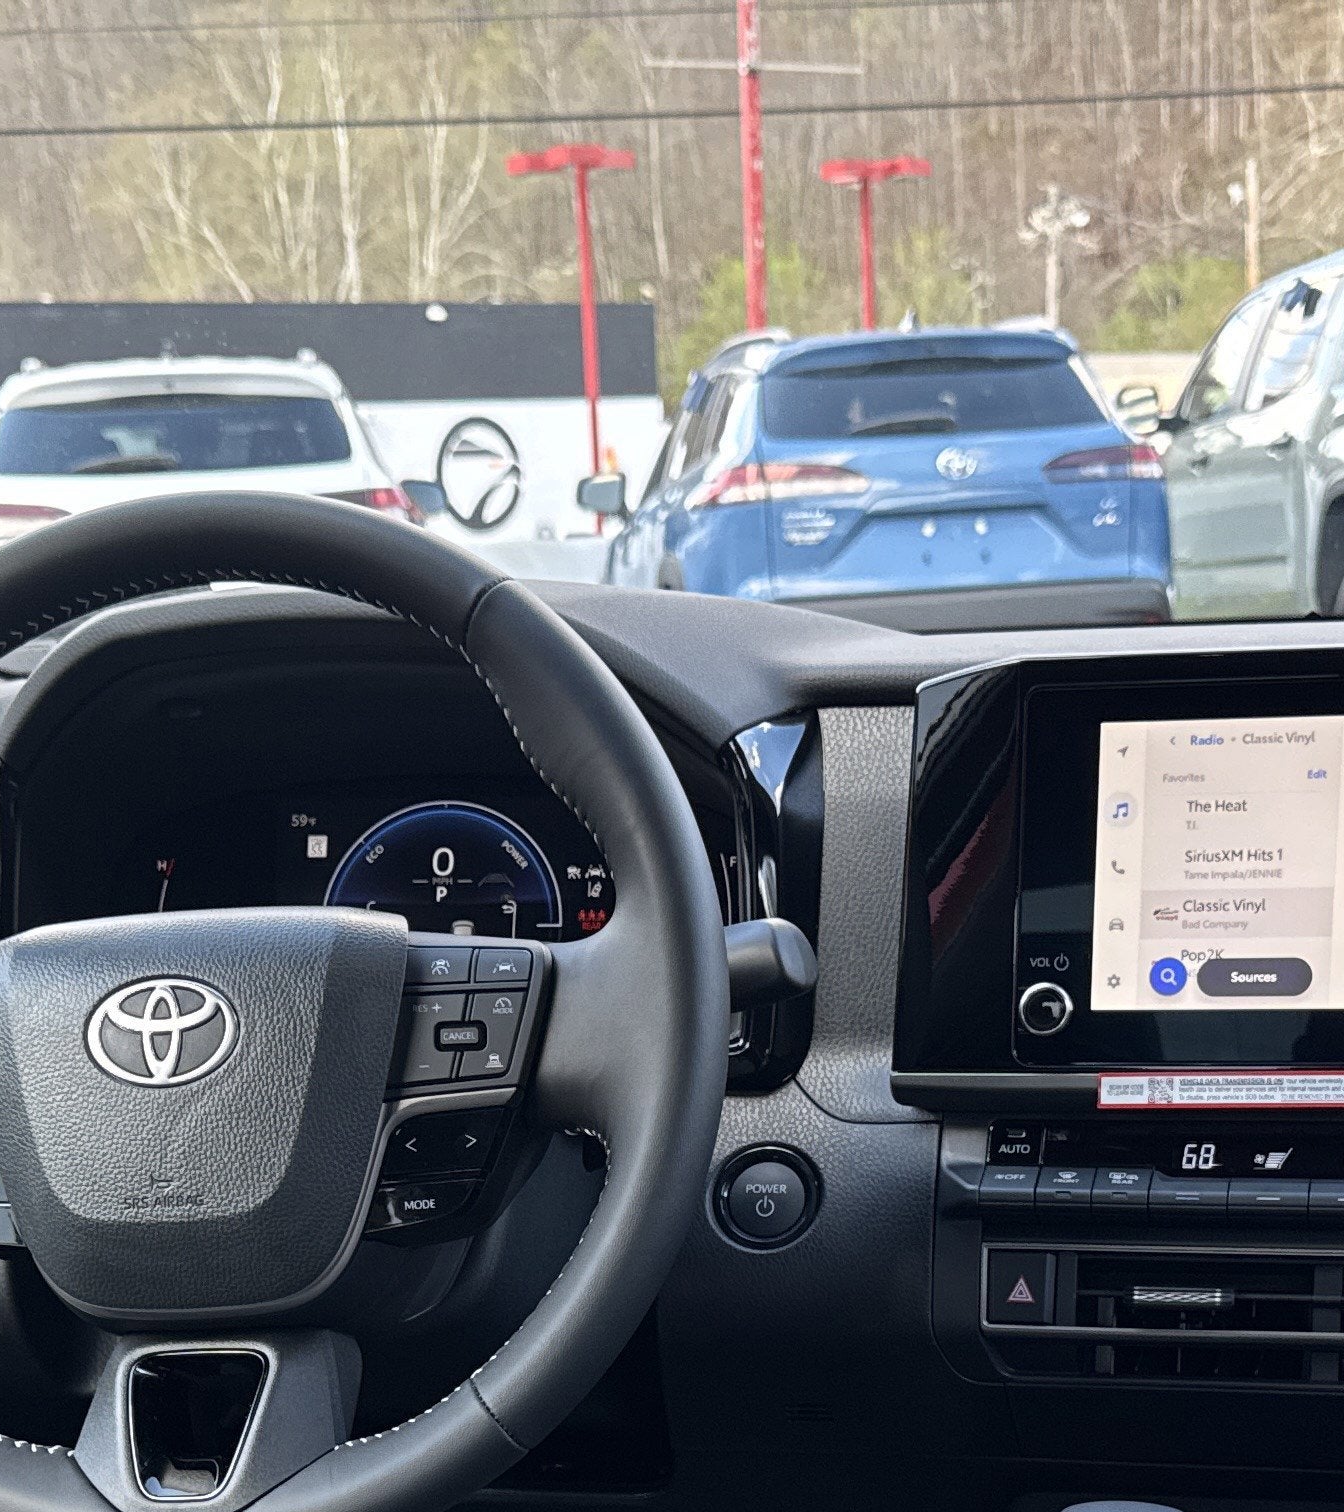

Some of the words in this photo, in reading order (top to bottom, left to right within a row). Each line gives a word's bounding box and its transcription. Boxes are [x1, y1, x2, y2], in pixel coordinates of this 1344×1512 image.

[1190, 734, 1224, 746] Radio
[1242, 732, 1284, 745] Classic
[1285, 730, 1316, 744] Vinyl
[1162, 772, 1205, 783] Favorites
[1306, 768, 1328, 780] Edit
[1186, 800, 1212, 813] The
[1214, 799, 1248, 813] Heat
[365, 843, 385, 865] ECO
[500, 839, 530, 870] POWER
[1184, 849, 1244, 864] SiriusXM
[1247, 849, 1274, 863] Hits
[1276, 848, 1284, 862] 1
[156, 859, 168, 872] H
[431, 846, 455, 877] 0
[729, 855, 737, 868] F
[431, 876, 454, 886] MPH
[1183, 870, 1208, 880] Tame
[435, 885, 448, 903] P
[1182, 899, 1231, 913] Classic
[1233, 898, 1267, 914] Vinyl
[581, 921, 602, 931] REAR
[1181, 919, 1201, 930] Bad
[1203, 919, 1249, 931] Company
[1180, 948, 1225, 962] Pop2K
[1029, 957, 1051, 968] VOL
[1230, 971, 1278, 984] Sources
[492, 1007, 514, 1015] MODE
[442, 1031, 476, 1041] CANCEL
[998, 1143, 1031, 1155] AUTO
[1181, 1143, 1216, 1170] 68
[745, 1183, 787, 1194] POWER
[124, 1196, 150, 1210] SRS
[404, 1198, 436, 1211] MODE
